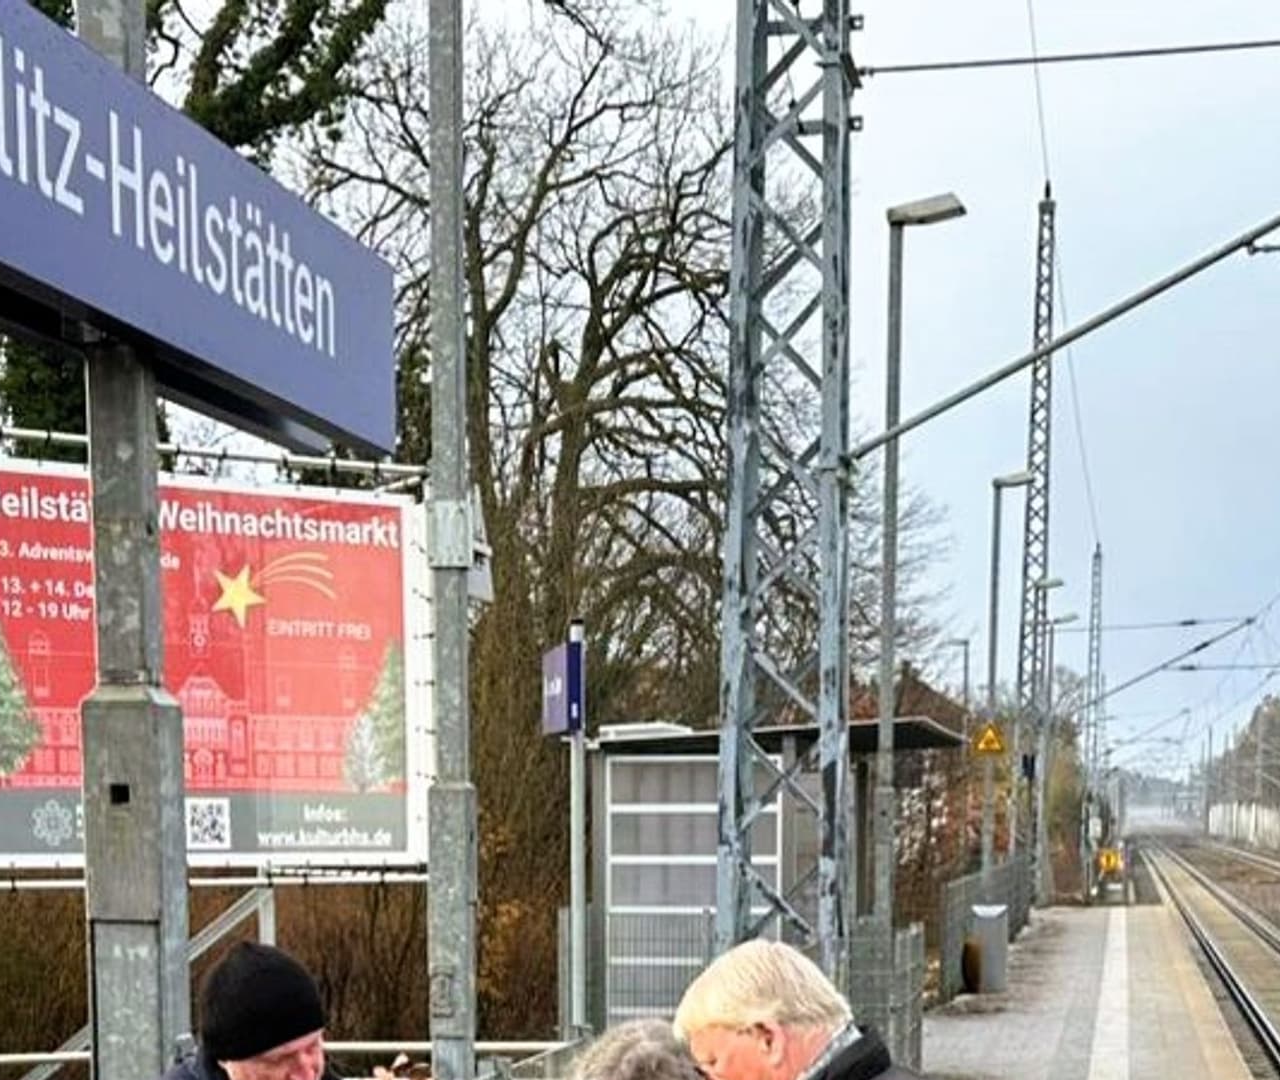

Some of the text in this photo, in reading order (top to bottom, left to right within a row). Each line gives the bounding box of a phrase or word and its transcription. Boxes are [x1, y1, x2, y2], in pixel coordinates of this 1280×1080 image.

[159, 500, 401, 548] Weihnachtsmarkt
[1, 576, 24, 594] 13.
[45, 580, 69, 597] 14.
[74, 581, 95, 599] De
[2, 600, 22, 617] 12
[39, 602, 59, 618] 19
[63, 603, 92, 621] Uhr
[267, 618, 372, 641] EINTRITT FREI
